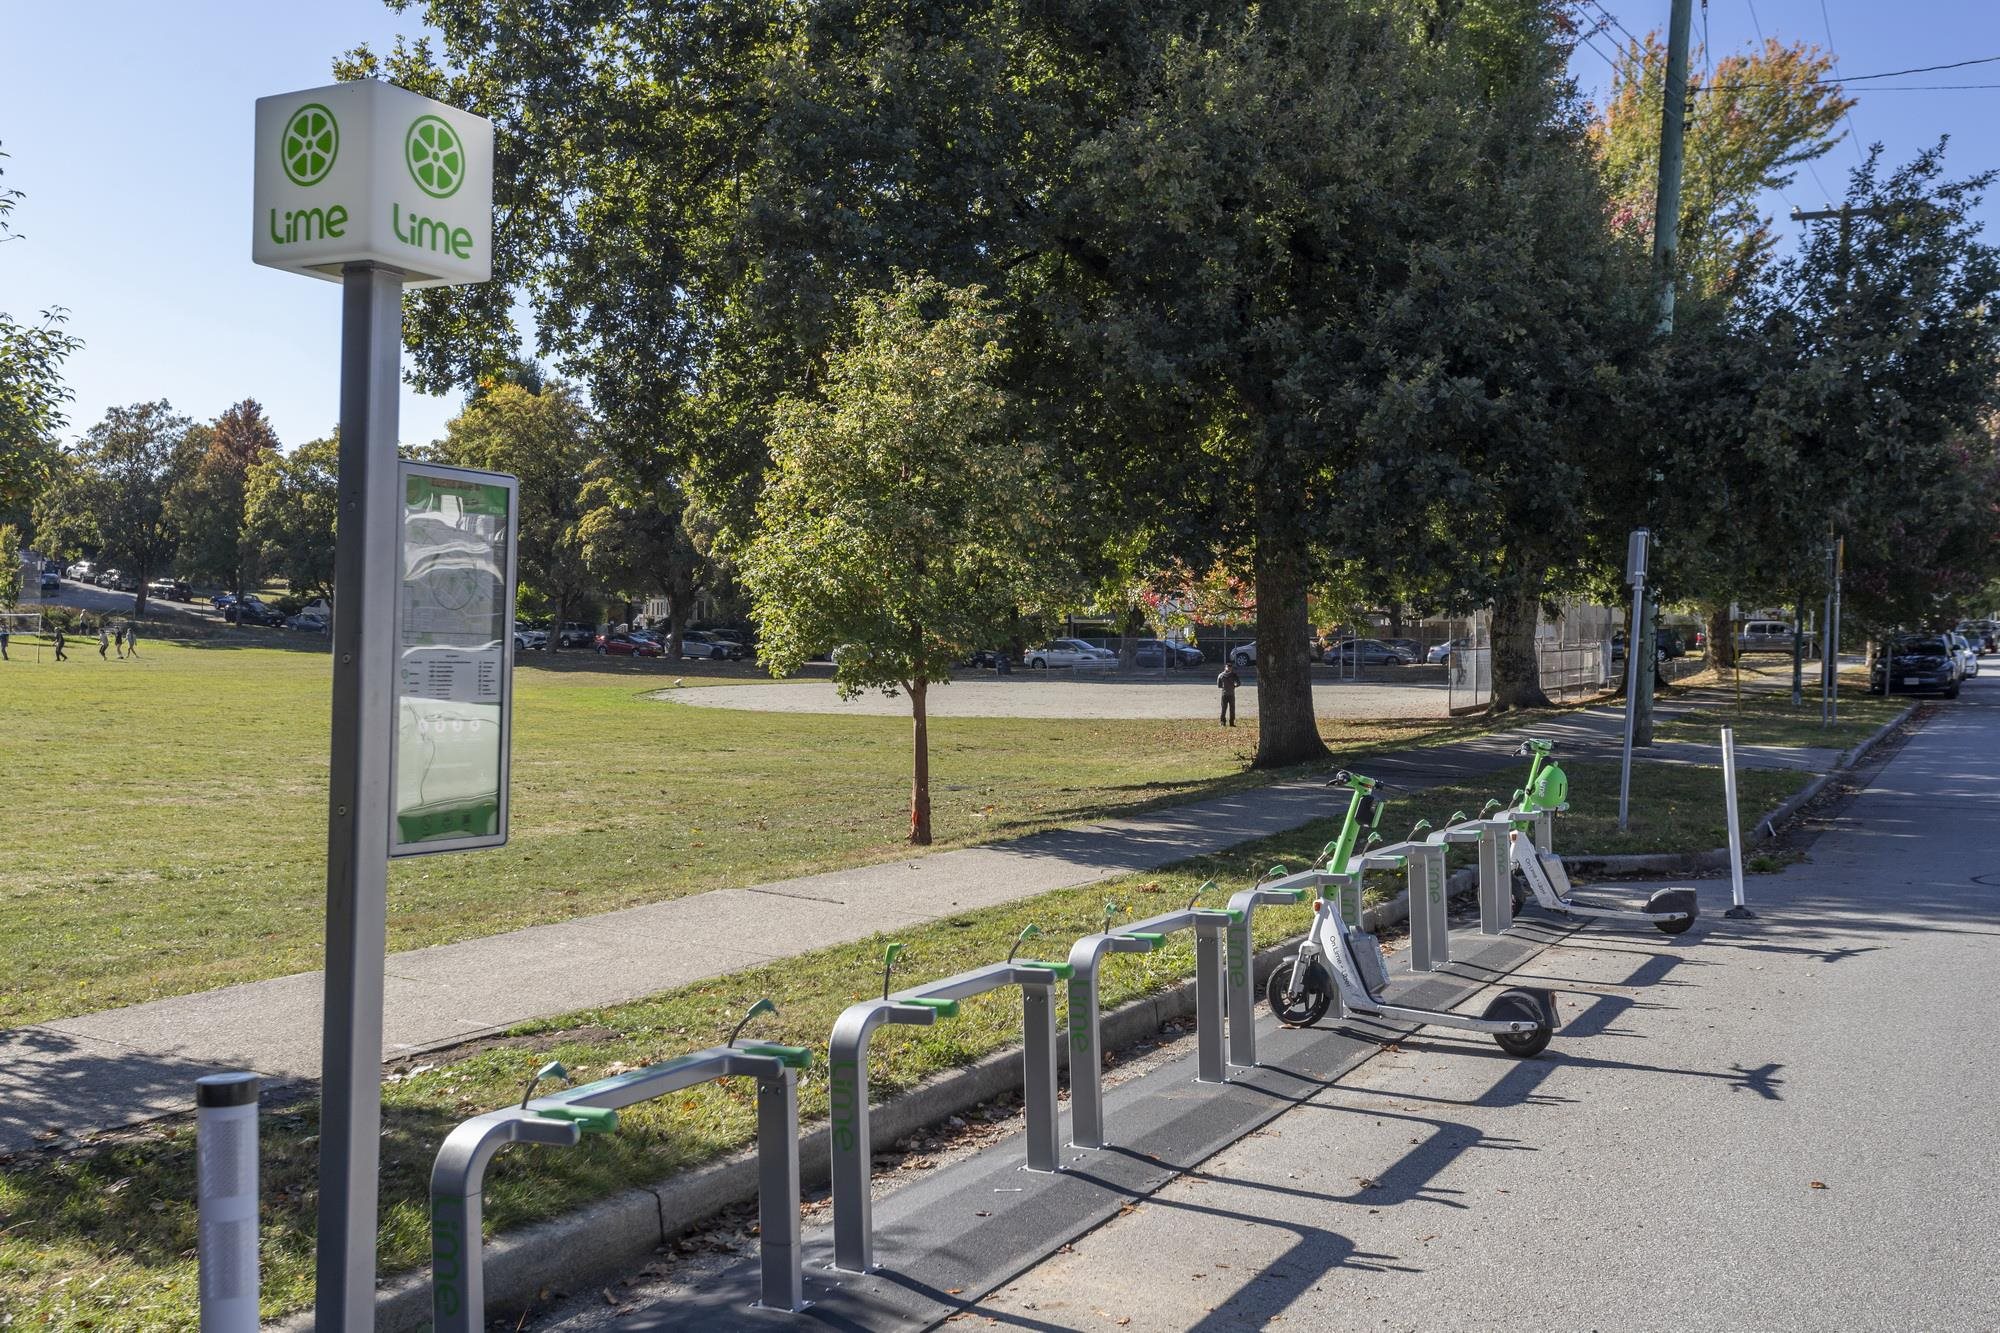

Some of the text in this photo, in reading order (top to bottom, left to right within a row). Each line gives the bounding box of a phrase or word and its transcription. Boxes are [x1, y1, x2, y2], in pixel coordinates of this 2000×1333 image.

[270, 204, 349, 245] Lime
[392, 202, 474, 260] Lime
[1229, 928, 1246, 987] Lime
[1068, 981, 1088, 1053] Lime
[830, 1060, 855, 1152] Lime
[431, 1195, 462, 1317] Lime
